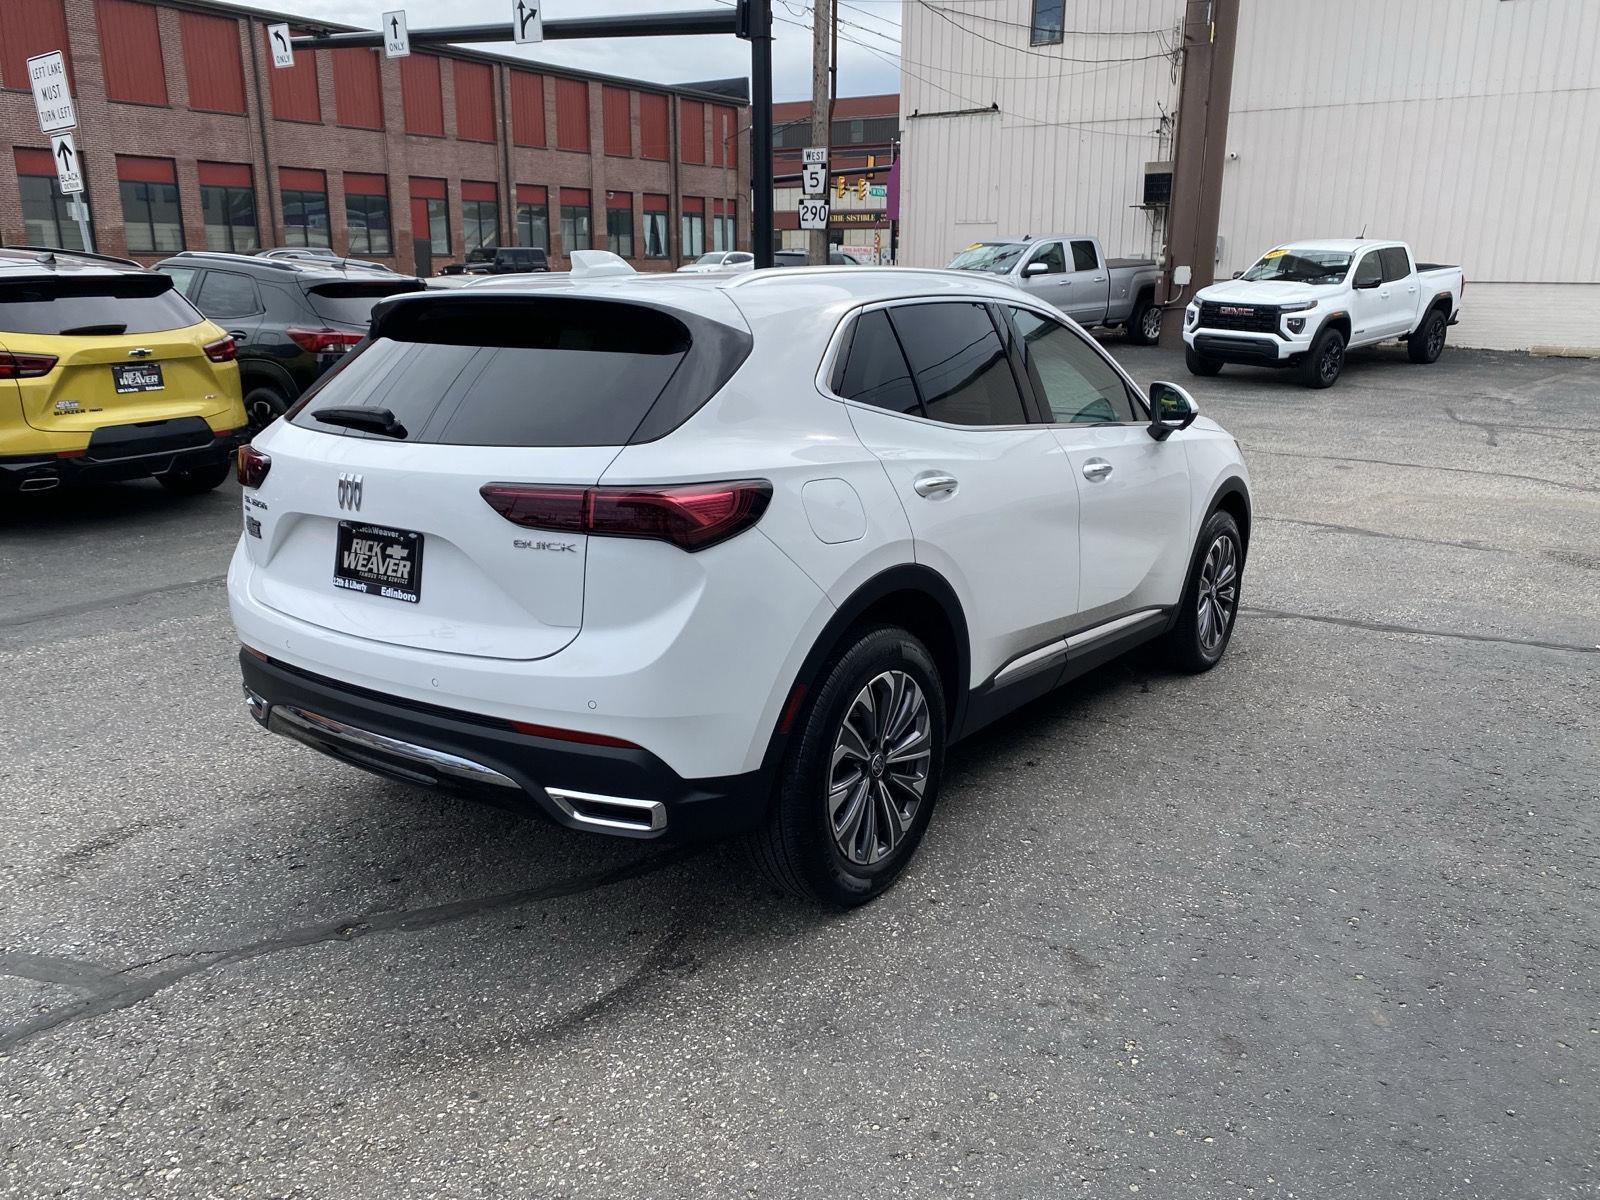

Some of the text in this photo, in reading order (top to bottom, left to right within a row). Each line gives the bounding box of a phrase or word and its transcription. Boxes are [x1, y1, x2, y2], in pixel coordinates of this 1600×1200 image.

[388, 41, 405, 51] ONLY
[276, 54, 291, 64] ONLY
[32, 62, 62, 80] LEFT LANE
[41, 84, 61, 101] MUST
[40, 106, 72, 123] TURN LEFT
[805, 151, 824, 161] WEST
[61, 172, 79, 183] BLACK
[809, 172, 819, 188] 5
[801, 205, 827, 221] 290
[1220, 306, 1254, 317] GMC
[119, 375, 158, 385] WEAVER
[351, 538, 384, 557] RICK
[513, 539, 576, 553] BUICK
[343, 551, 411, 579] WEAVER
[350, 581, 367, 592] Liberty
[381, 587, 416, 601] Edinboro
